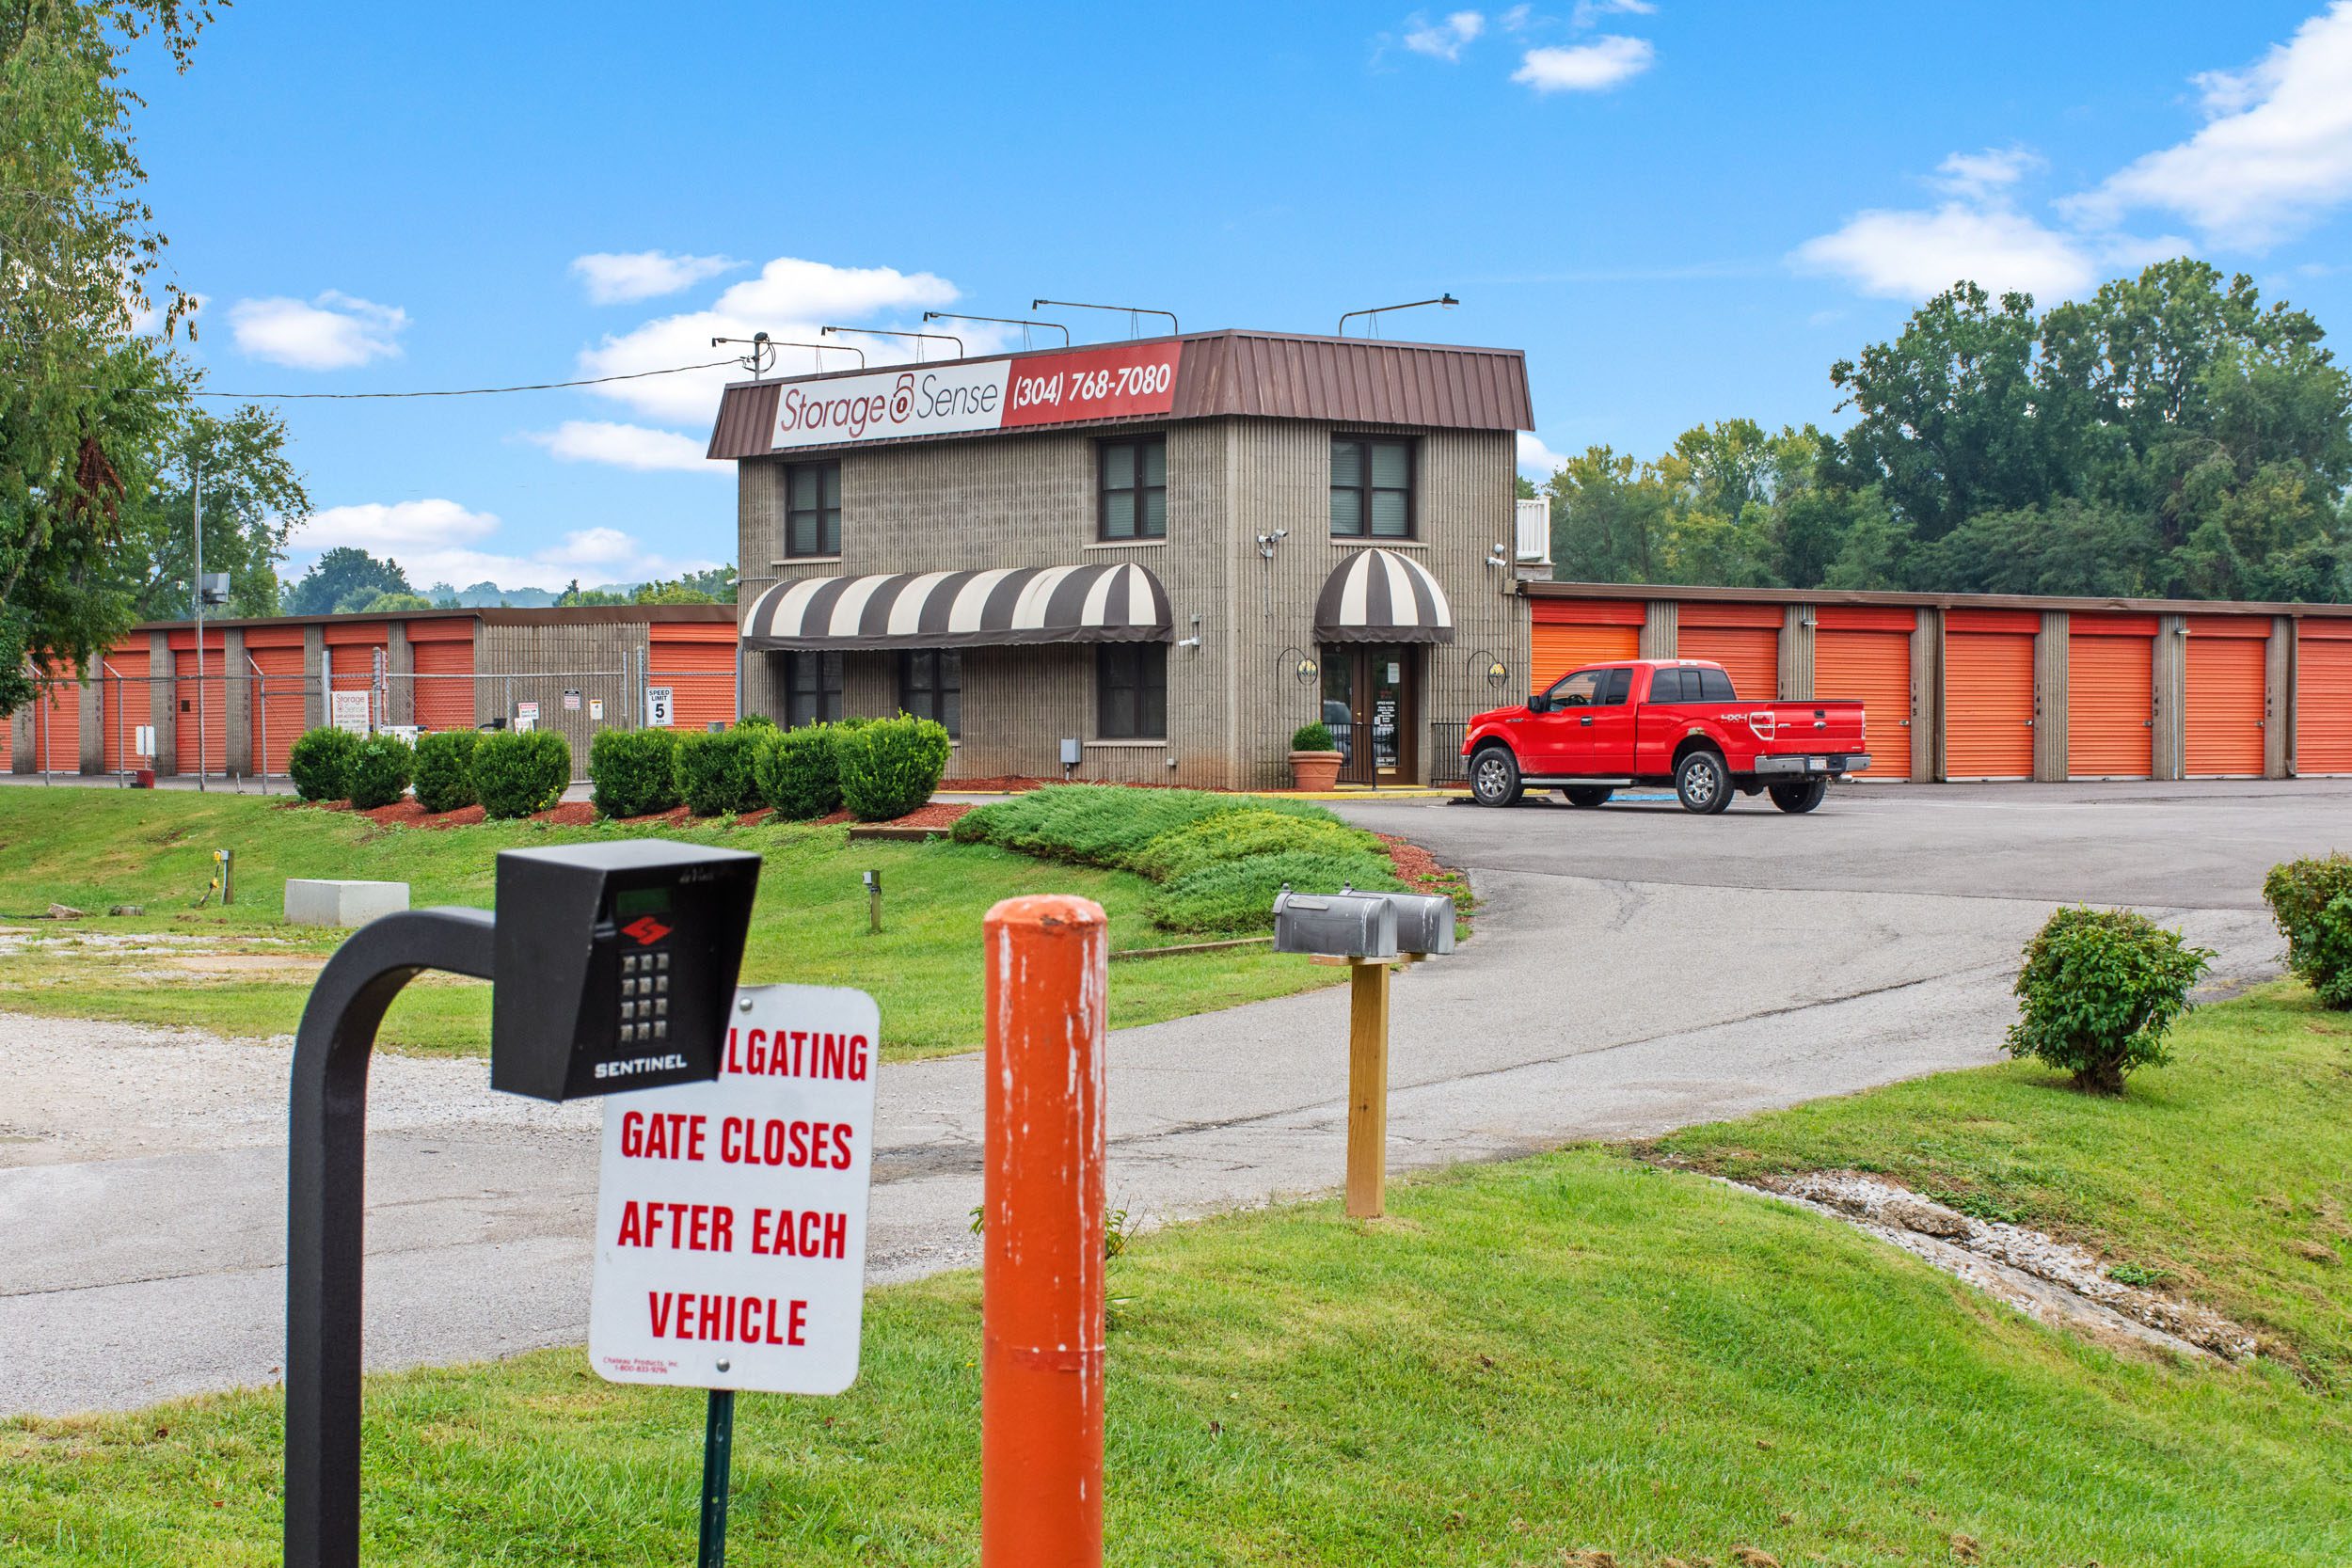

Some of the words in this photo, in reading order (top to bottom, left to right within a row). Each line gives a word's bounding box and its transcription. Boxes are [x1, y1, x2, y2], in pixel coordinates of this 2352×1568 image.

[780, 388, 884, 438] Storage
[916, 374, 998, 419] Sense
[1013, 372, 1064, 408] (304)
[1069, 363, 1171, 402] 768-7080
[336, 694, 365, 705] Storage
[344, 704, 365, 713] Sense
[655, 703, 665, 719] 5
[595, 1053, 688, 1079] SENTINEL
[720, 1028, 868, 1082] LGATING
[621, 1111, 707, 1162] GATE
[721, 1117, 853, 1171] CLOSES
[617, 1200, 735, 1253] AFTER
[752, 1208, 847, 1259] EACH
[649, 1291, 807, 1347] VEHICLE
